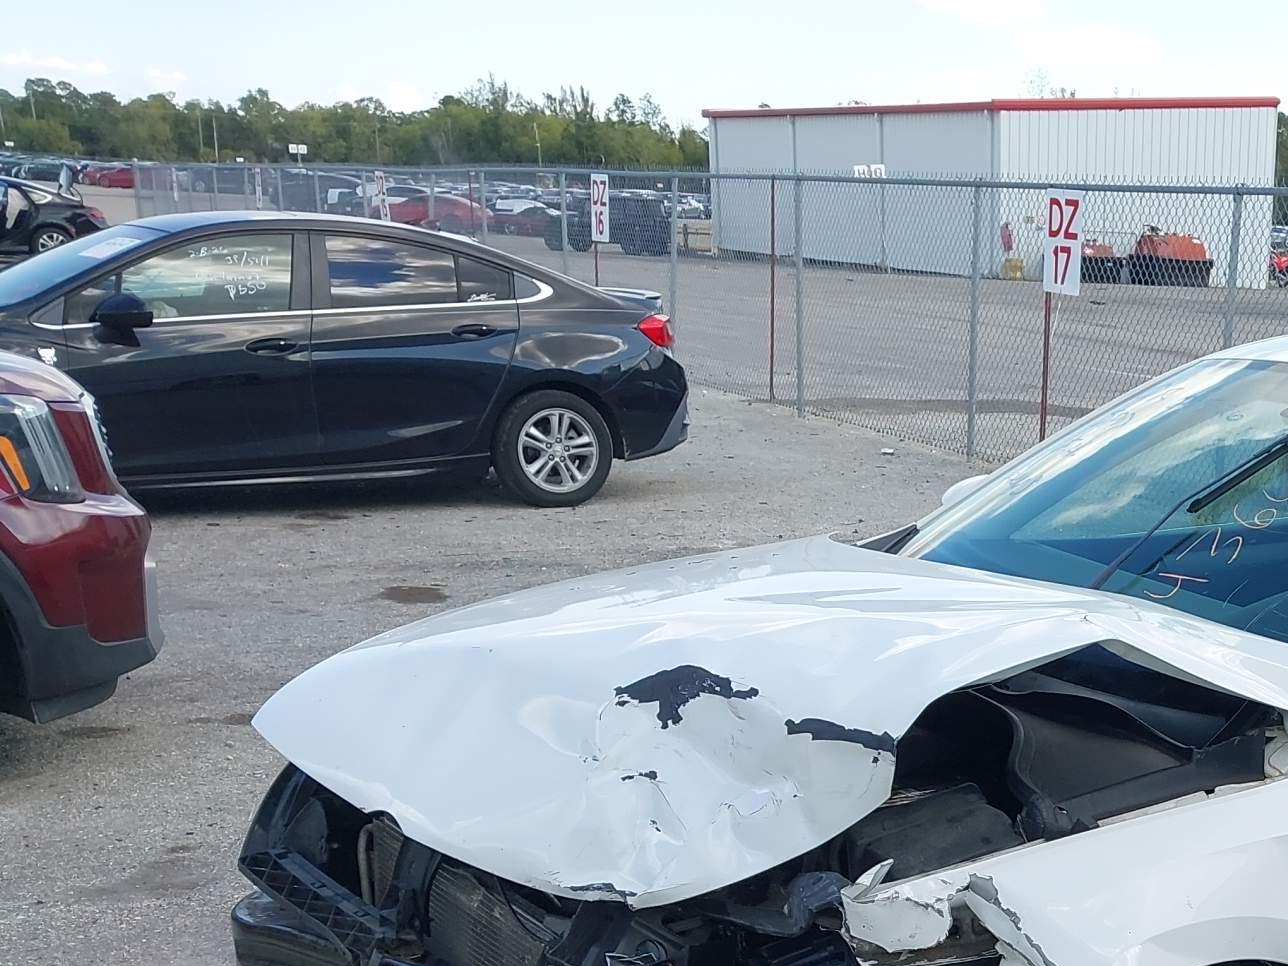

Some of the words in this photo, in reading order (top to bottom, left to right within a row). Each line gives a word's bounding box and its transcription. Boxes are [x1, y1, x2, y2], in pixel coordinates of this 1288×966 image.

[593, 180, 607, 206] DZ
[595, 210, 604, 235] 16
[1049, 197, 1080, 240] DZ
[1053, 245, 1072, 284] 17
